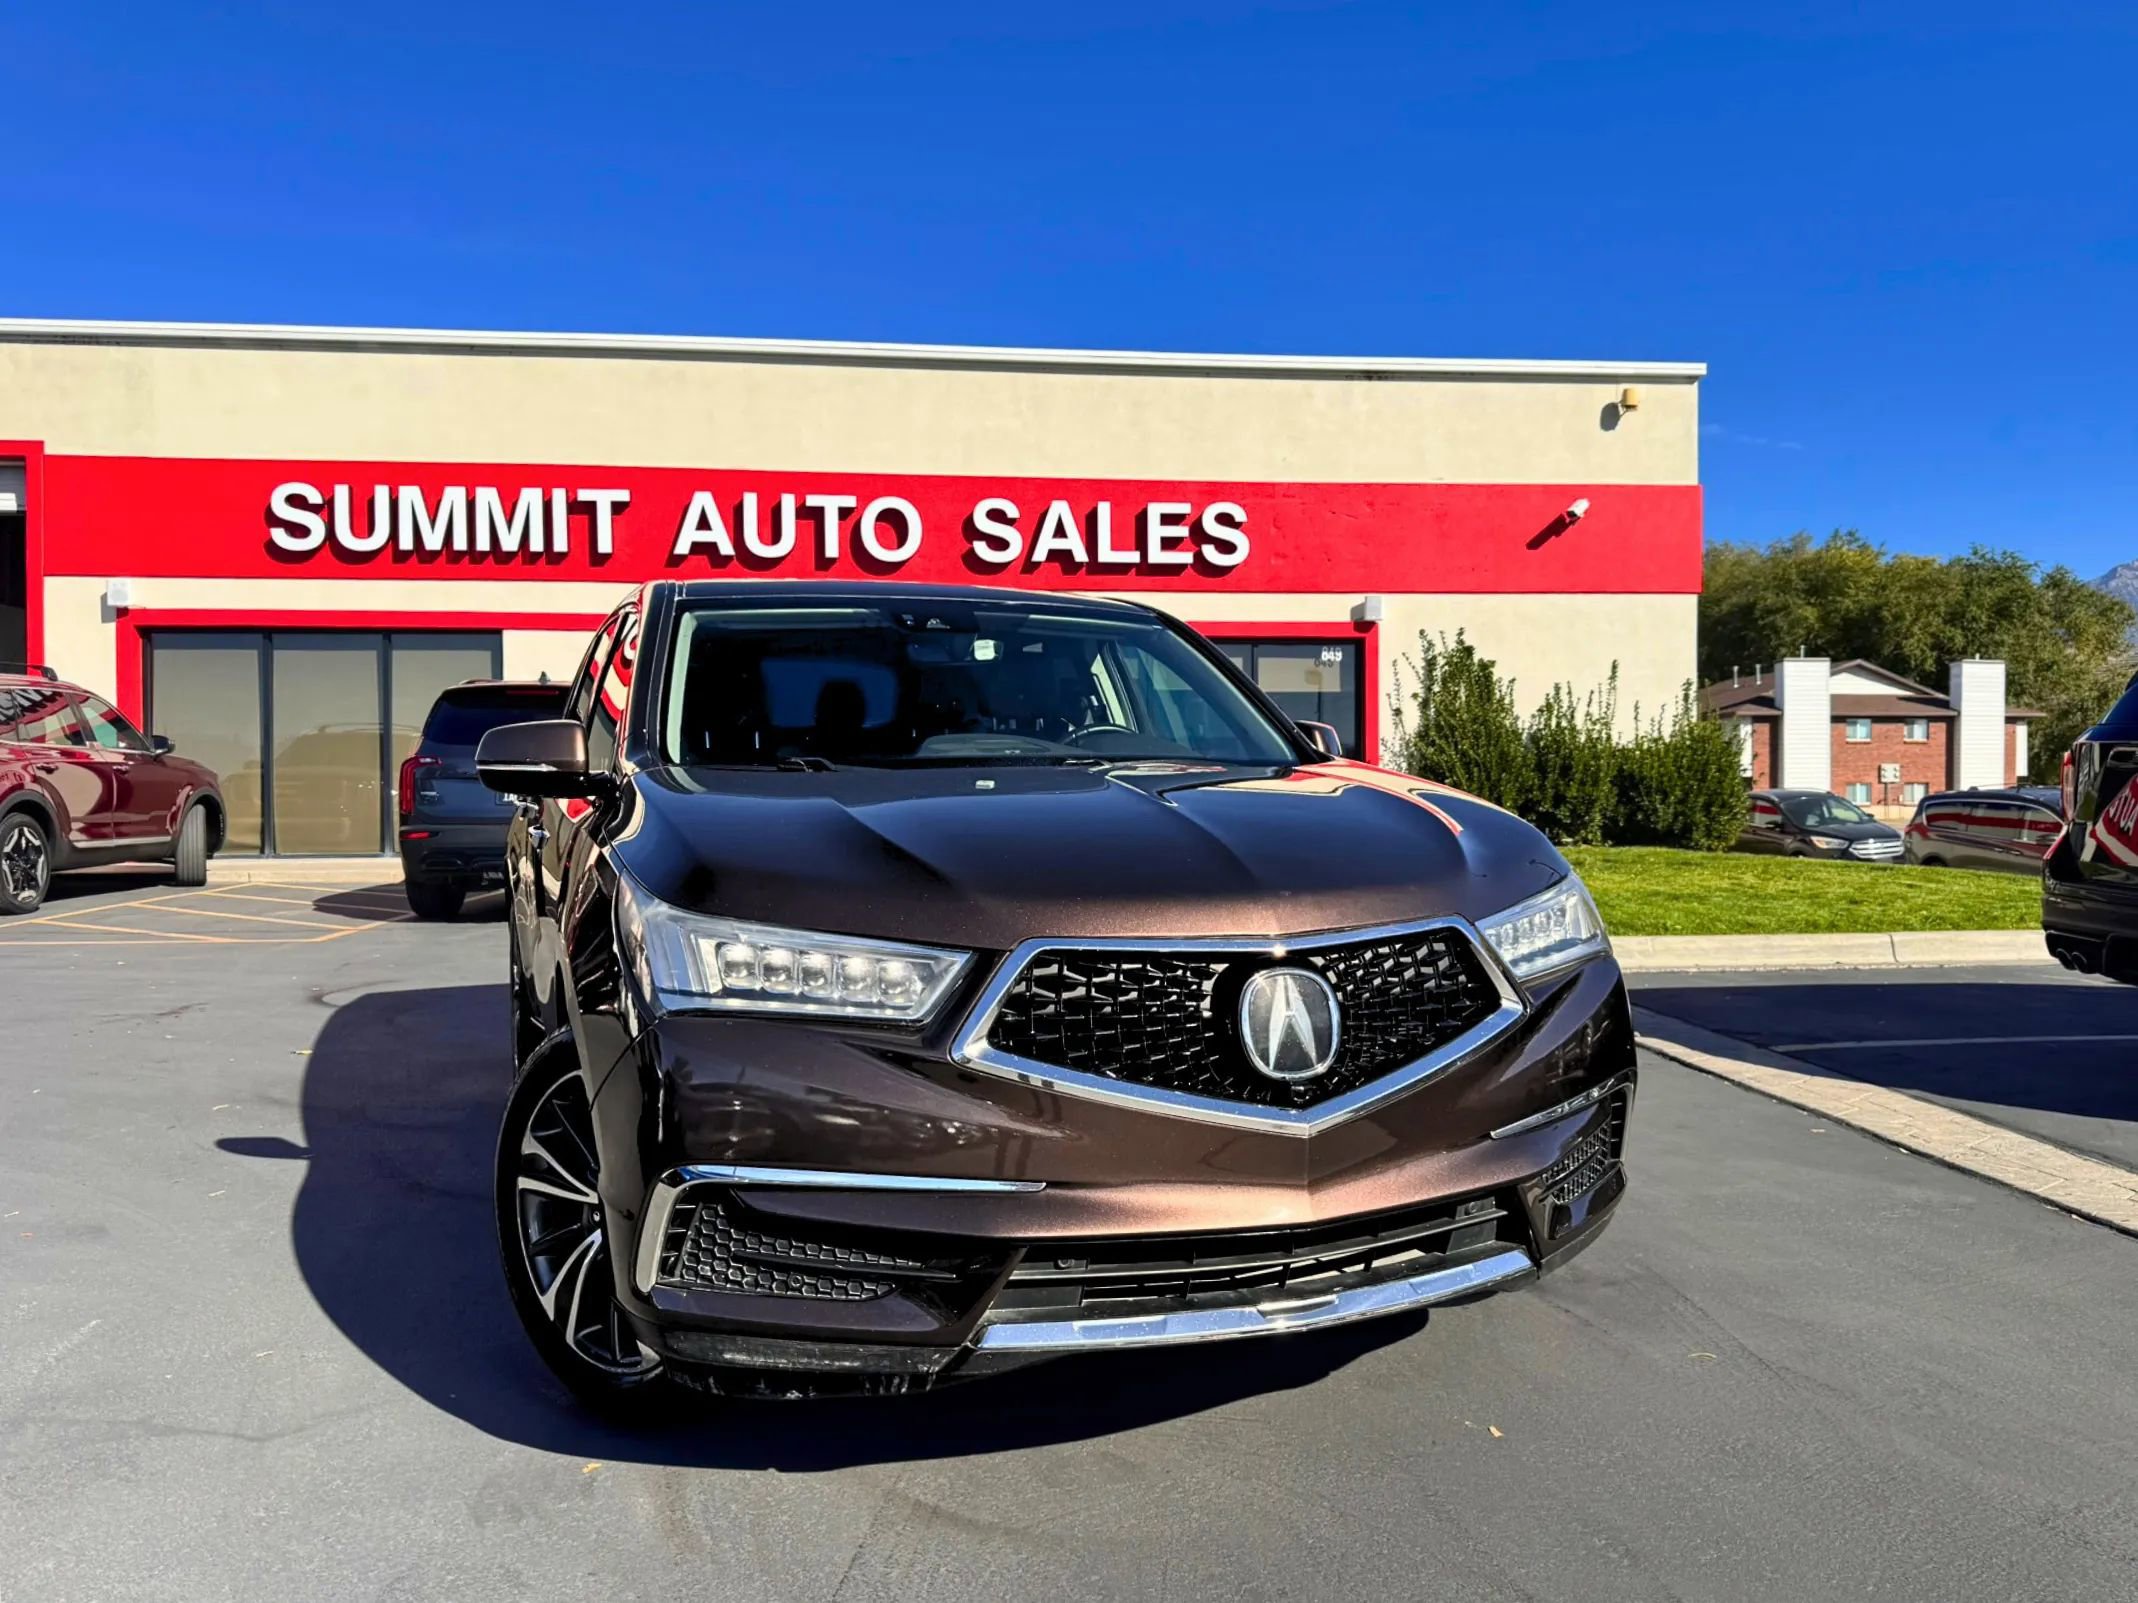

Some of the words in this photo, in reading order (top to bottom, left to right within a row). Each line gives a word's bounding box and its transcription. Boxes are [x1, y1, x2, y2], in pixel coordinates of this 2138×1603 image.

[269, 482, 631, 553] SUMMIT
[673, 491, 923, 563] AUTO
[972, 497, 1250, 567] SALES
